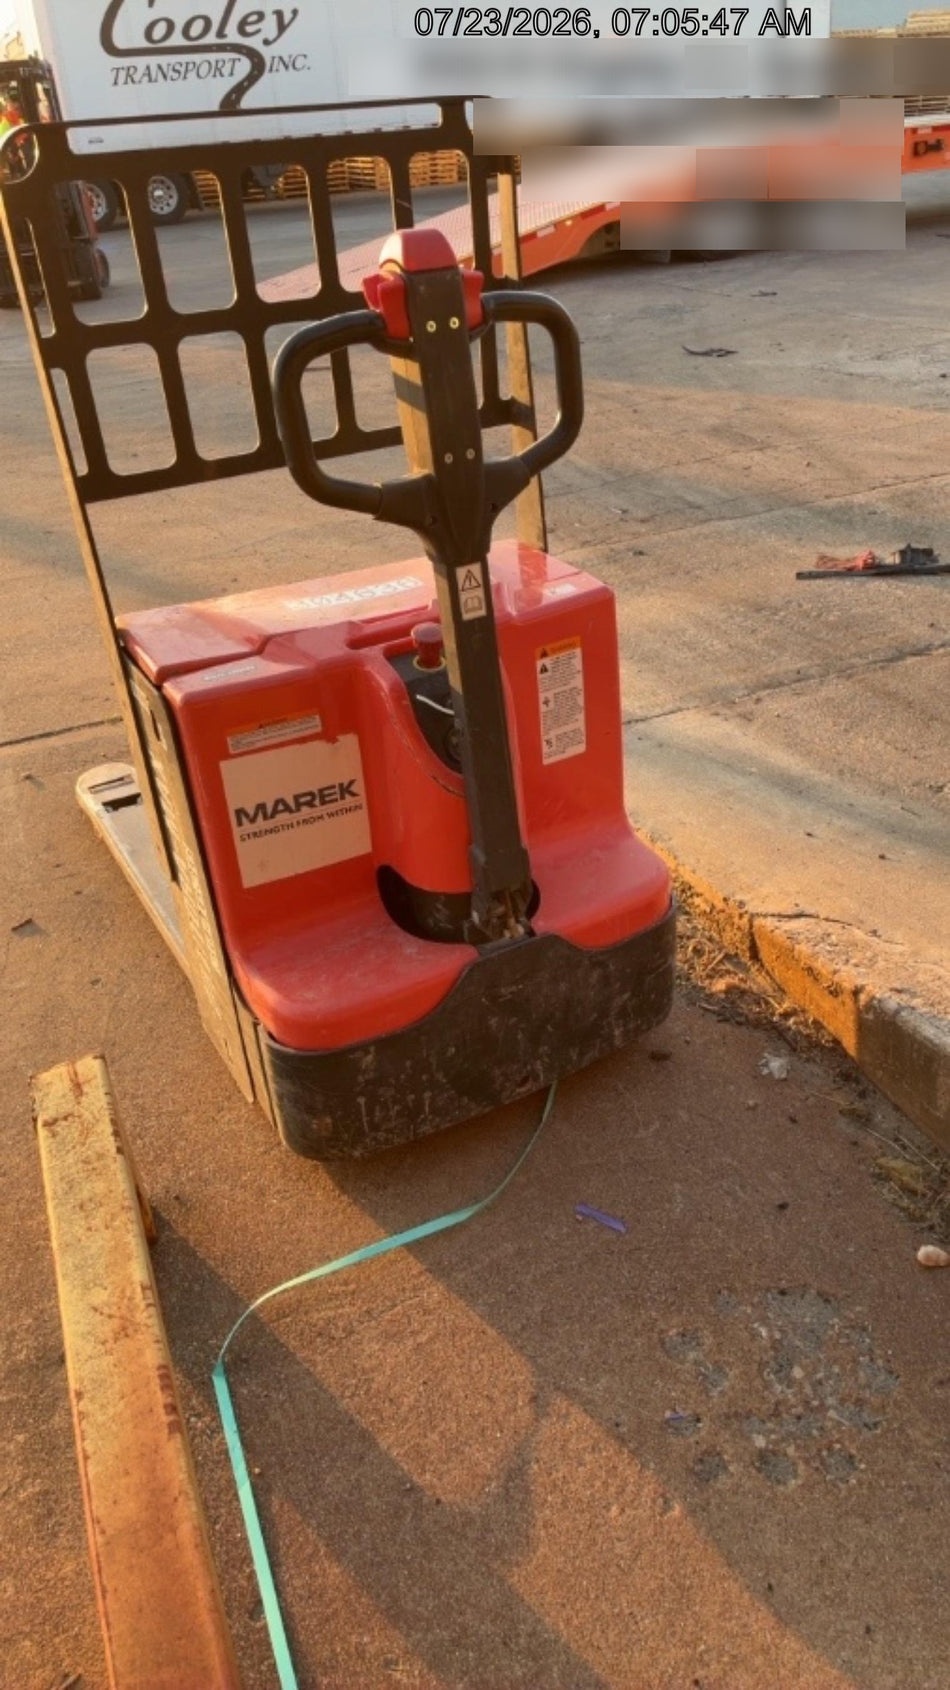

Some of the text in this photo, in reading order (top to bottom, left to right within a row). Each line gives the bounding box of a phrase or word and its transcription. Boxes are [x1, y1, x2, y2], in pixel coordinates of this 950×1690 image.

[99, 0, 300, 57] Cooley
[110, 54, 311, 86] TRANSPORT INC.
[234, 779, 360, 827] MAREK
[239, 803, 363, 842] STRENGTH FROM WITHIN
